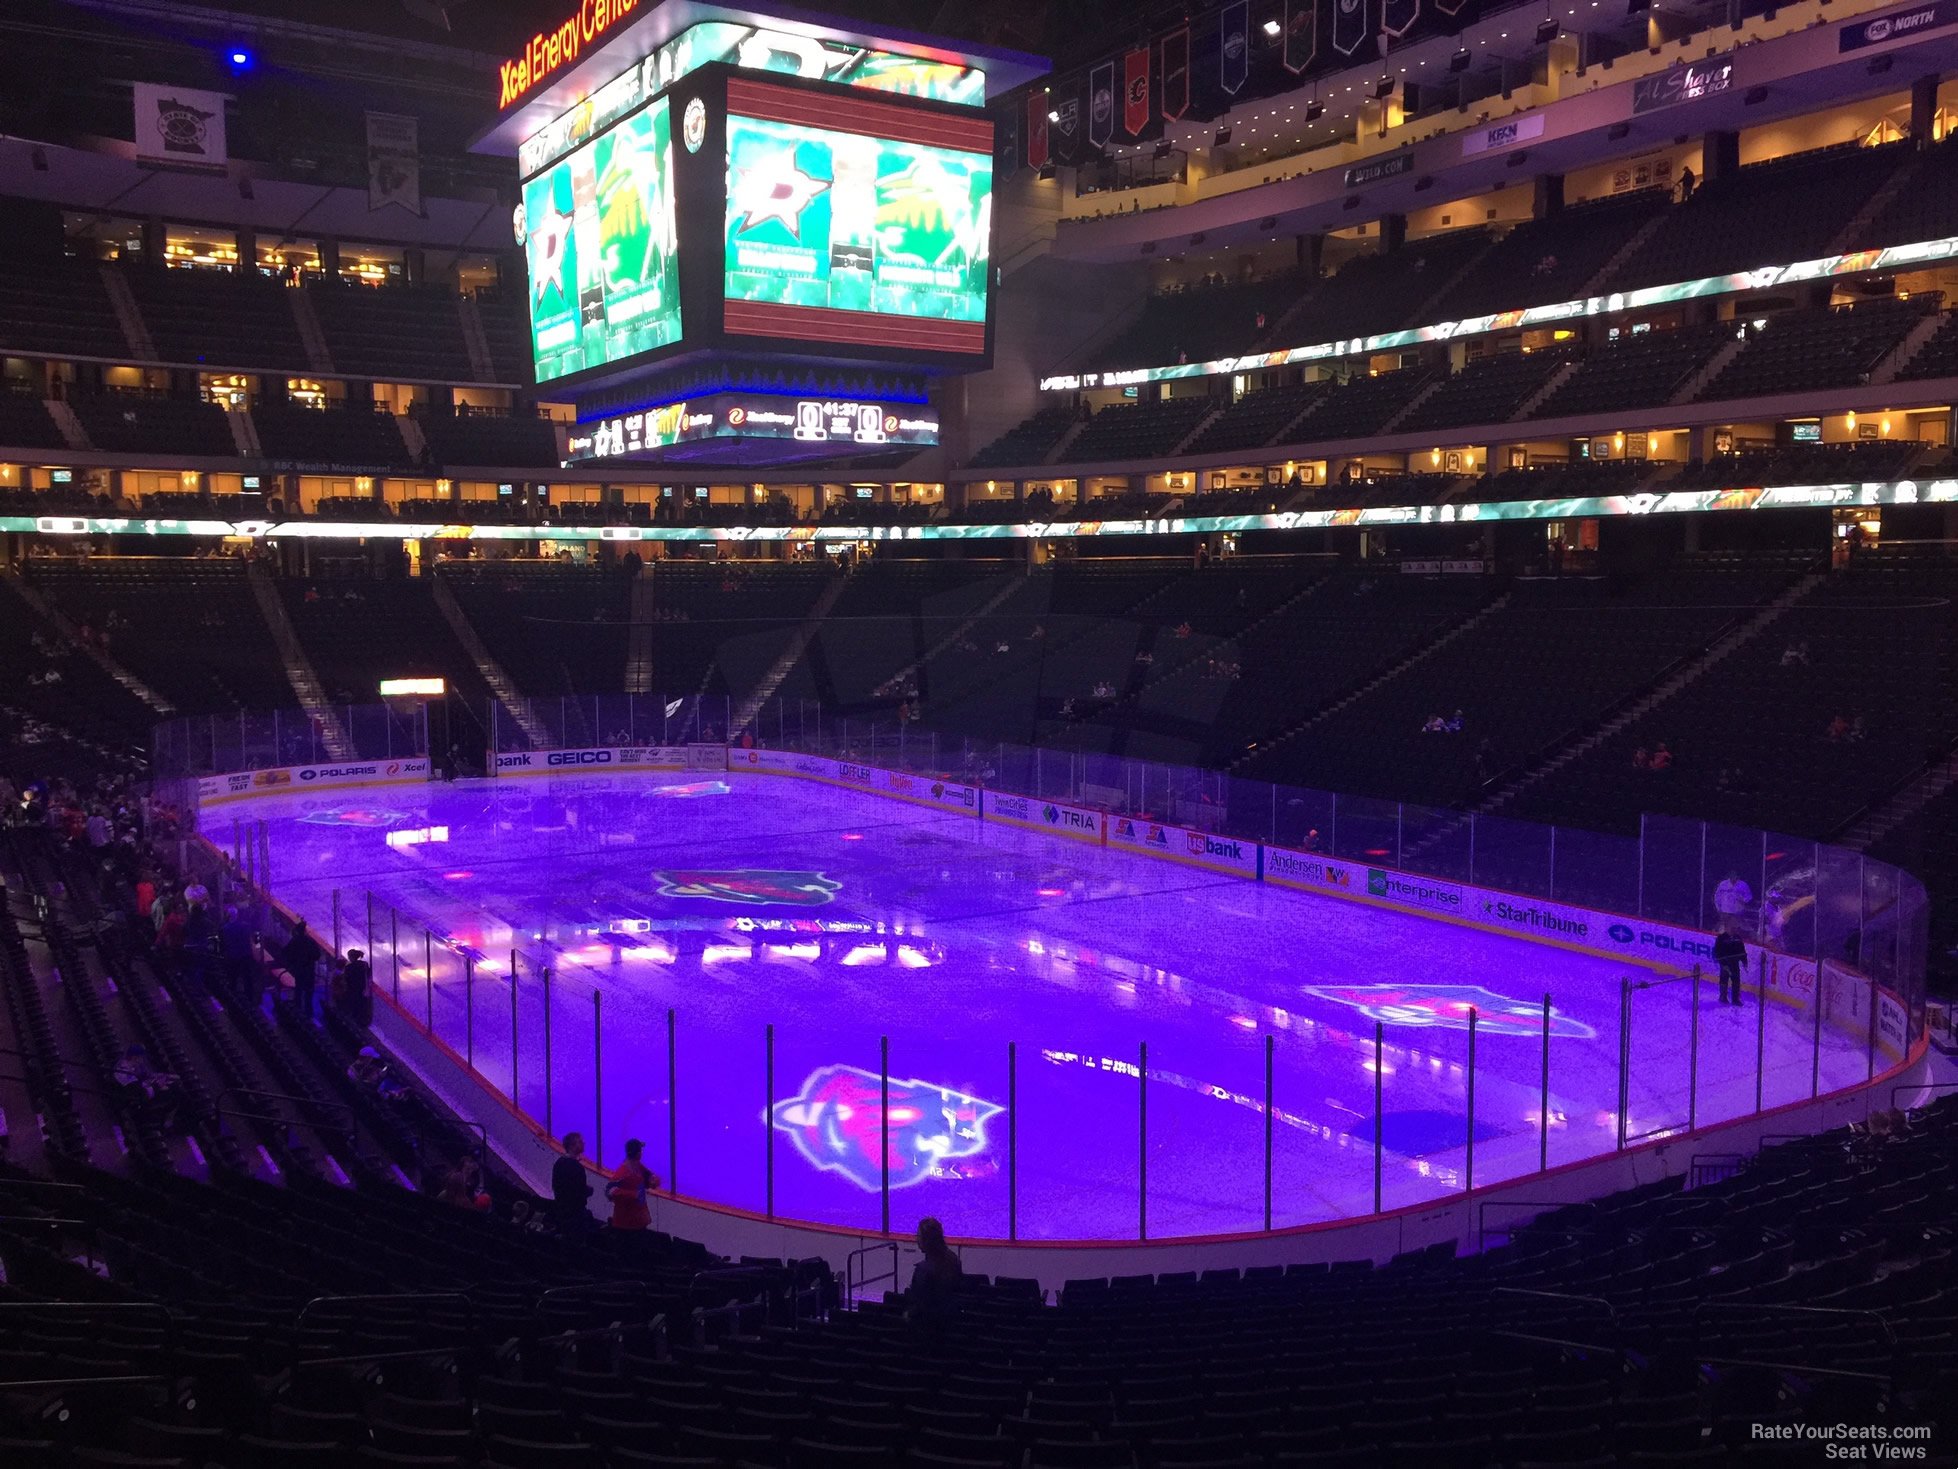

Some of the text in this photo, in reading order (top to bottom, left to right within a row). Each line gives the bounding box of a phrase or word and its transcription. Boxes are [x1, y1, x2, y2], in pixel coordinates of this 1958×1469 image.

[1870, 9, 1935, 34] FOX NORTH
[499, 0, 638, 109] Xcel Energy Cen
[1661, 65, 1732, 99] Shaver
[1708, 79, 1731, 93] BOX
[296, 462, 329, 472] Wealth
[331, 463, 391, 474] Management
[404, 763, 427, 773] Xcel
[547, 750, 612, 766] GEICO
[319, 766, 377, 778] POLARIS
[839, 763, 871, 780] LOFFLER
[1061, 810, 1095, 831] TRIA
[1205, 835, 1244, 861] bank
[1270, 851, 1323, 876] Andersen
[1496, 902, 1589, 937] StarTribune
[1640, 931, 1716, 961] POLAR
